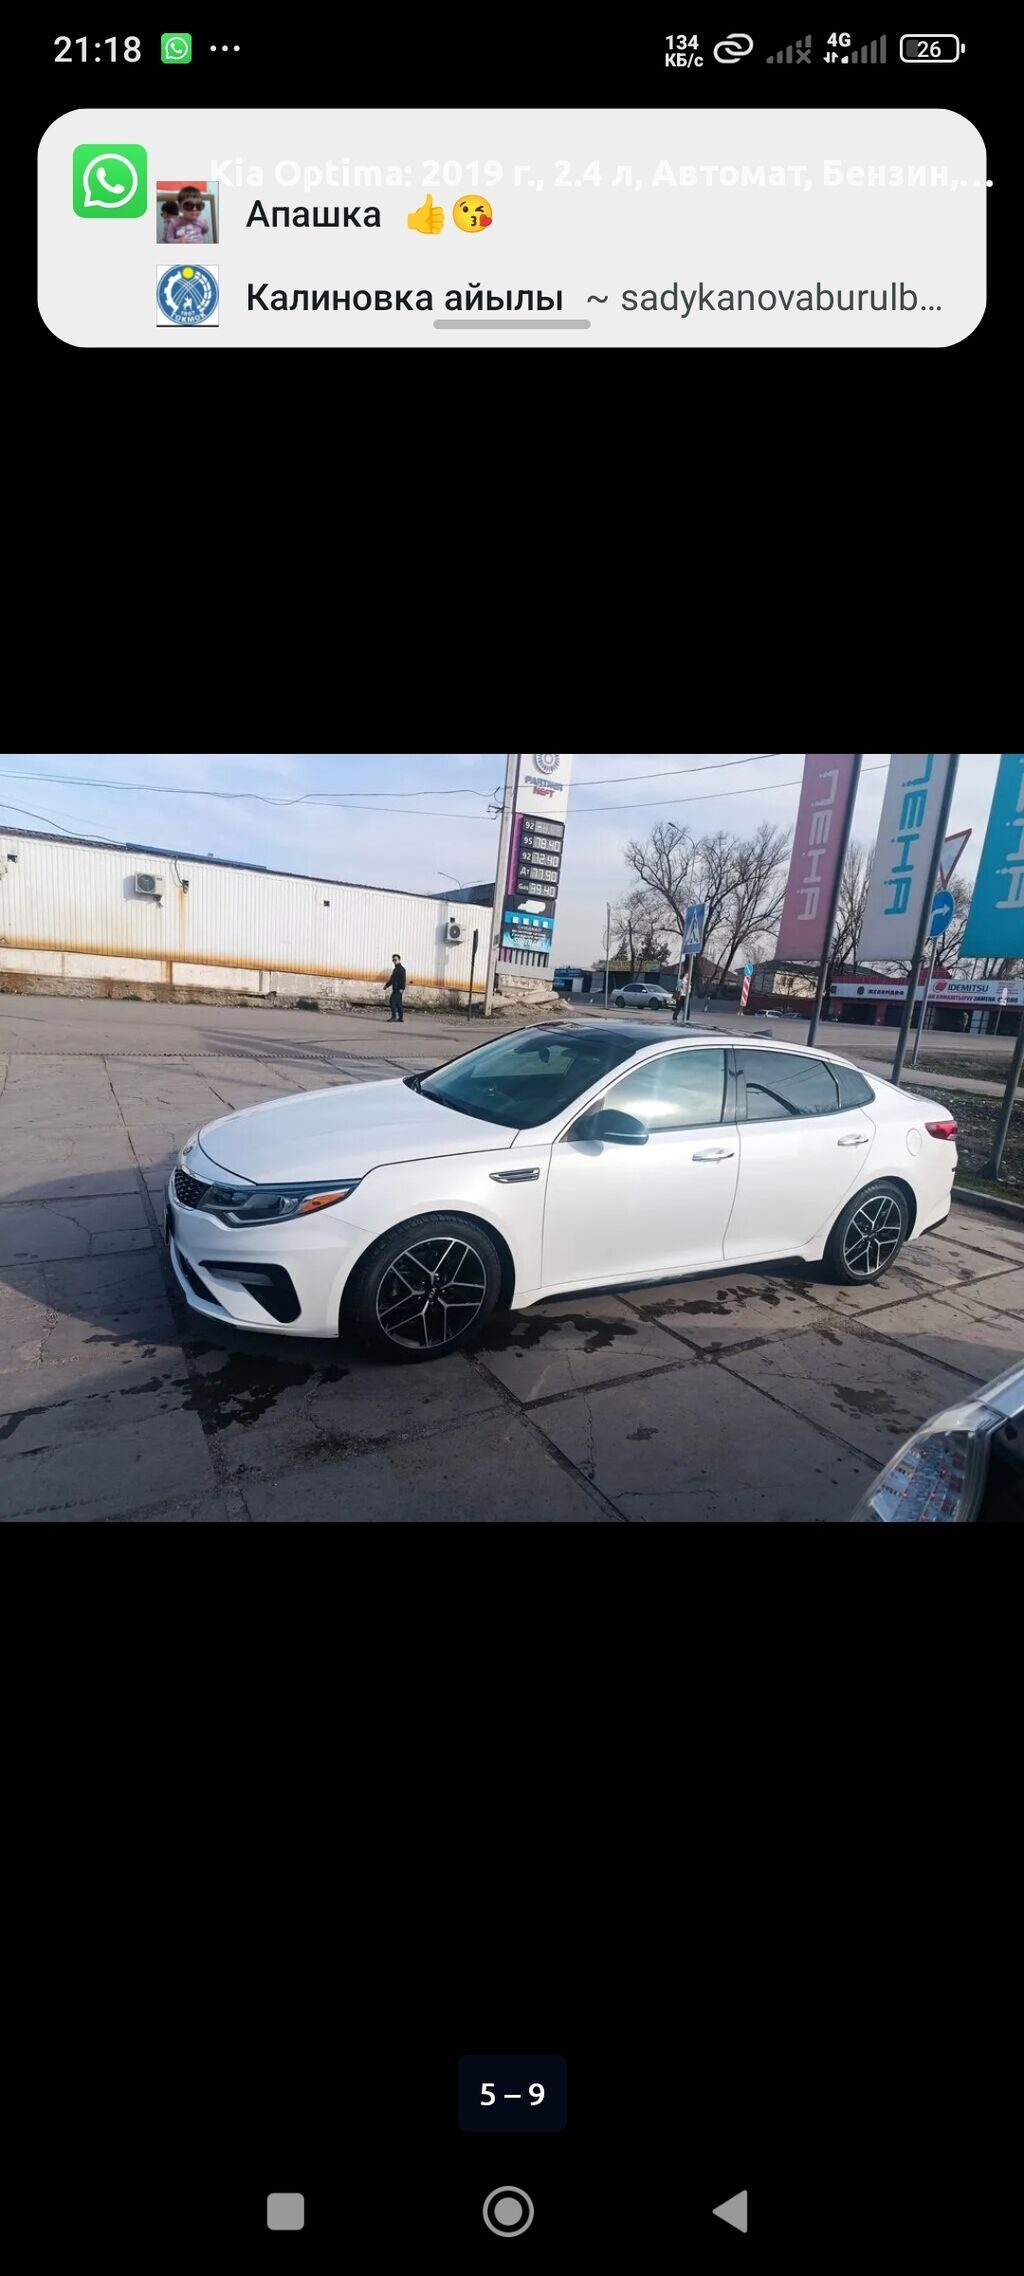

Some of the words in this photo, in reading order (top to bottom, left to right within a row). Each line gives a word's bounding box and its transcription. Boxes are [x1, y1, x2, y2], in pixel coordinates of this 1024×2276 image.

[525, 821, 534, 830] 92
[524, 836, 533, 845] 95
[948, 983, 989, 993] IDEMITSU
